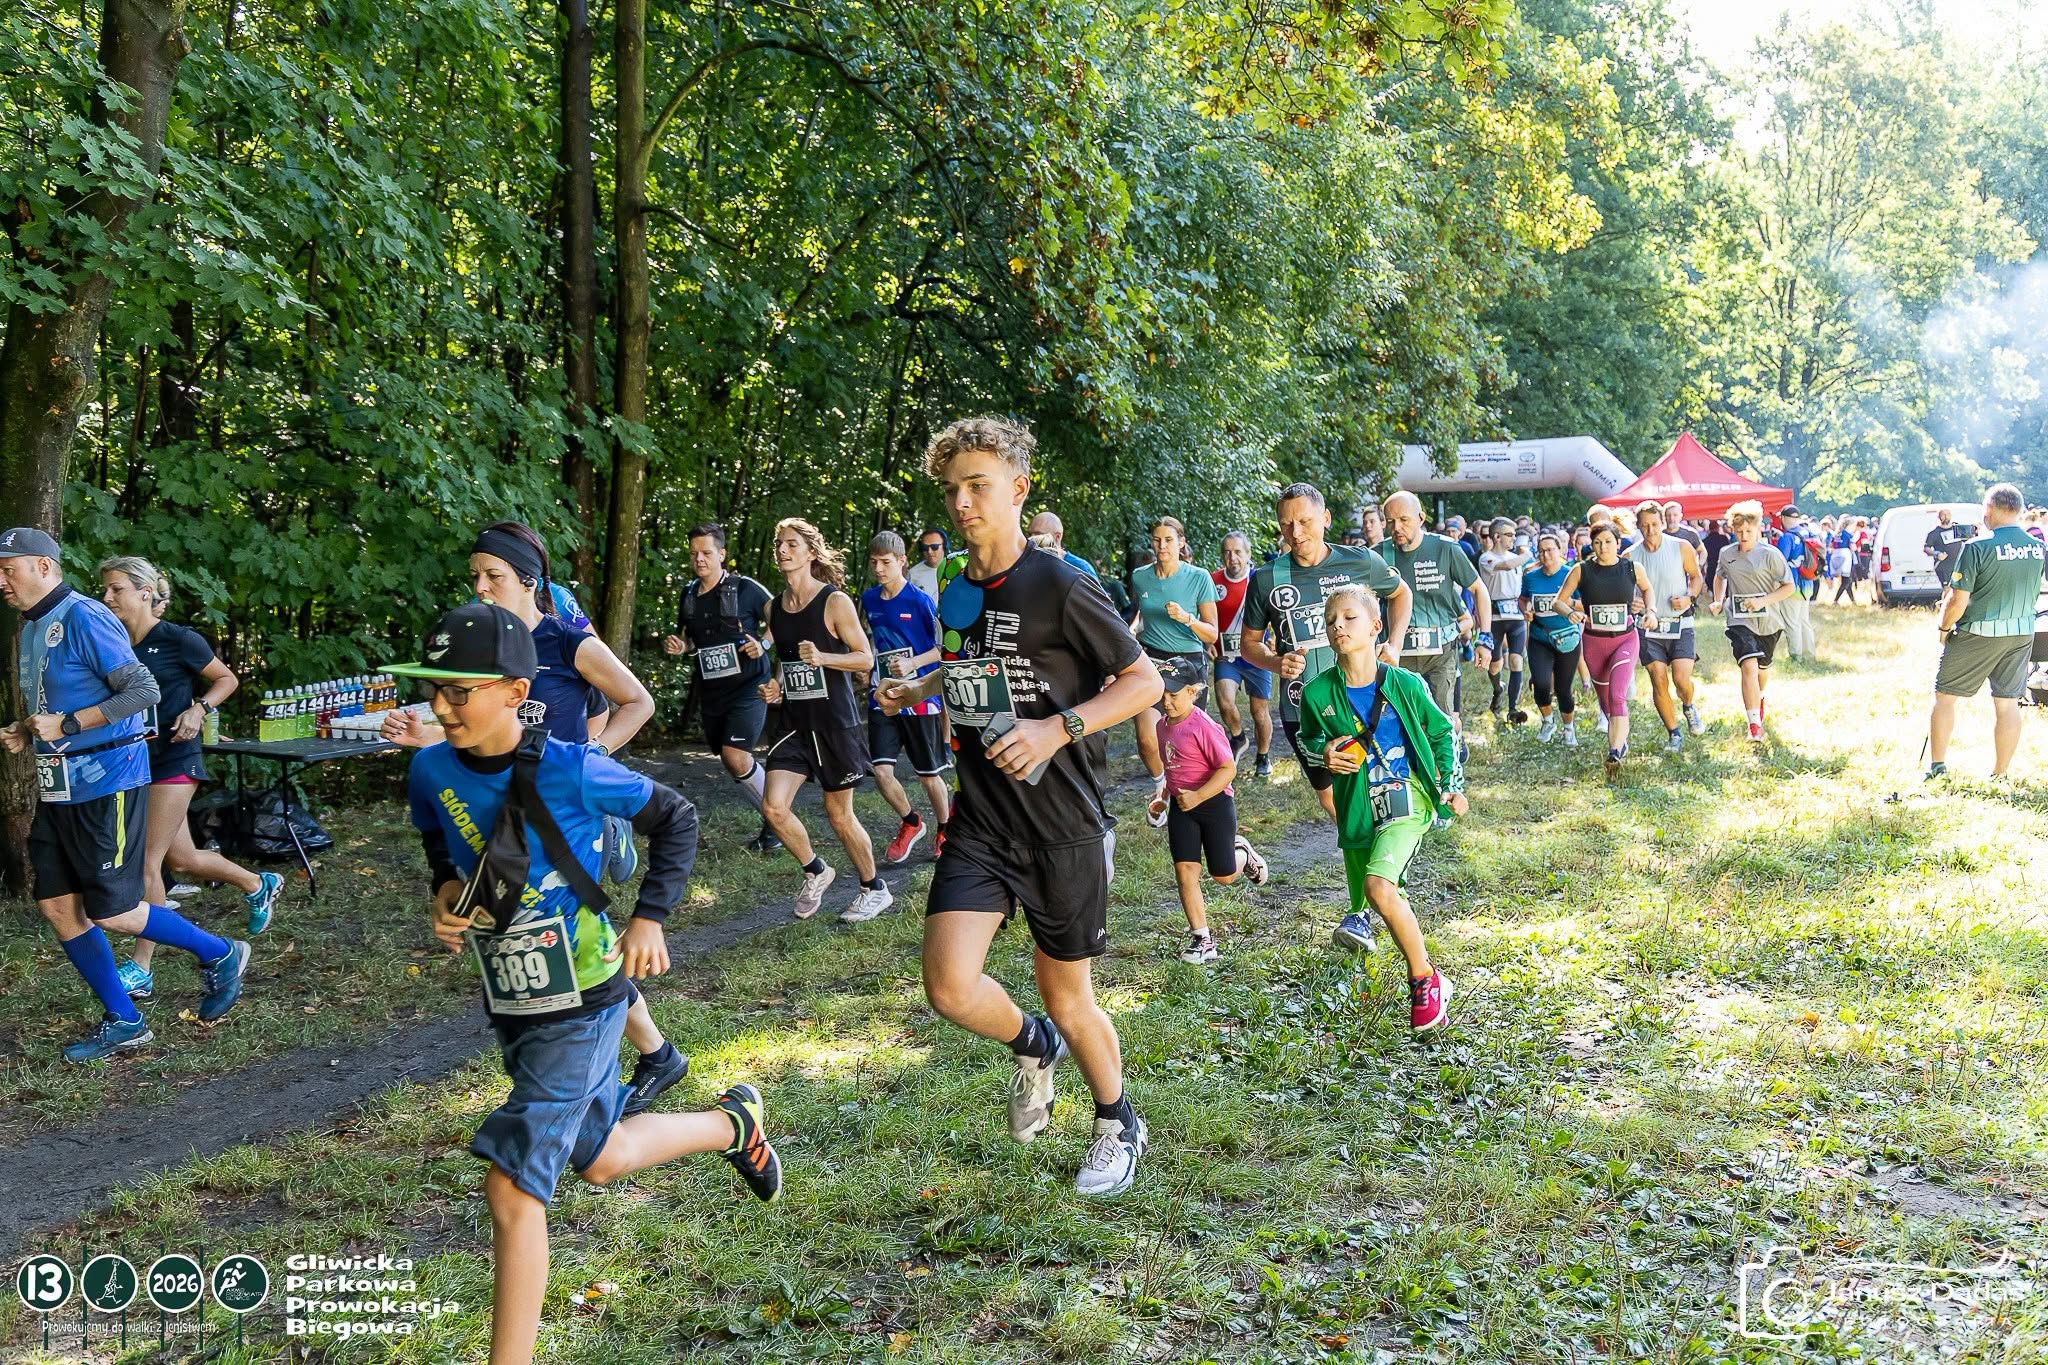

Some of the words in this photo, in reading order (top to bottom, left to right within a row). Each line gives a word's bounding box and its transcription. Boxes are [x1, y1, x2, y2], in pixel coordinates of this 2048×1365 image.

[1582, 460, 1617, 490] GARMIN
[1319, 573, 1350, 585] Gliwicka
[1275, 588, 1295, 607] 13
[1410, 632, 1431, 647] 110
[705, 654, 729, 670] 396
[787, 671, 816, 687] 1176
[944, 678, 989, 707] 307
[438, 788, 487, 856] SIÓDEM
[490, 951, 550, 992] 389
